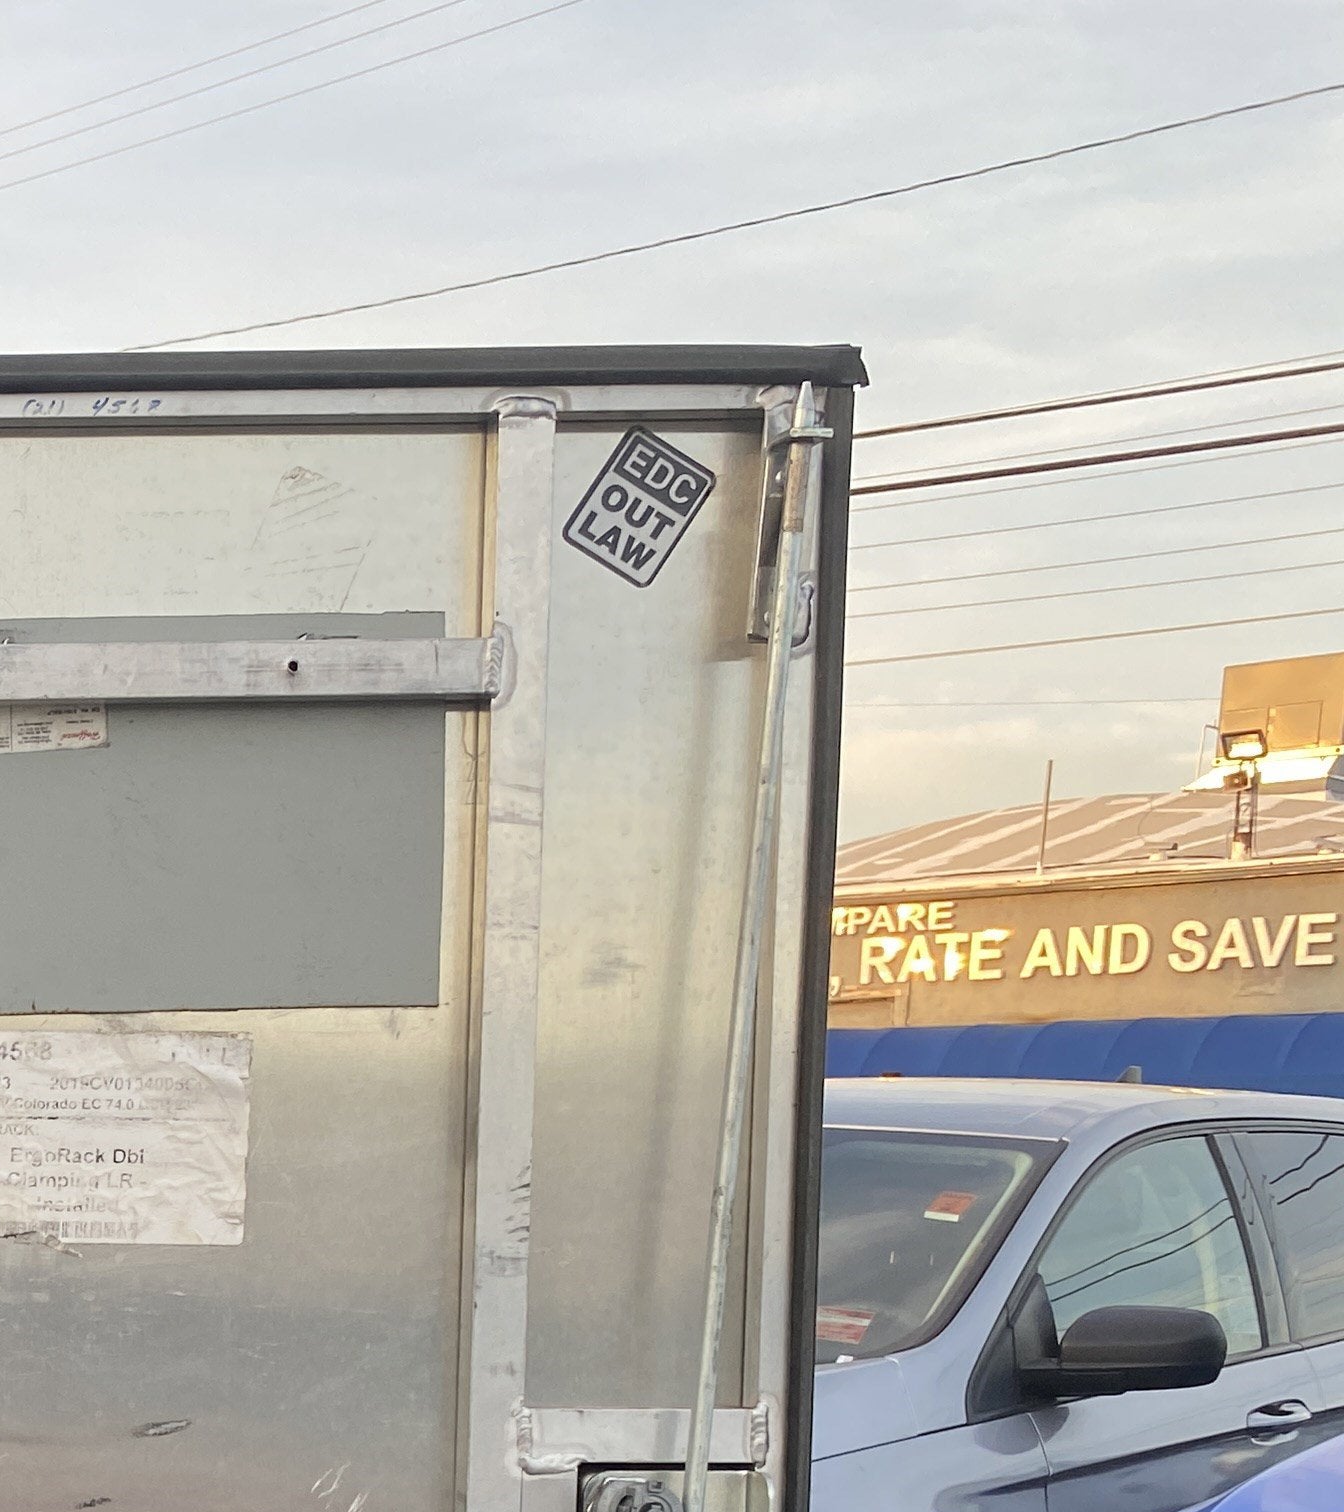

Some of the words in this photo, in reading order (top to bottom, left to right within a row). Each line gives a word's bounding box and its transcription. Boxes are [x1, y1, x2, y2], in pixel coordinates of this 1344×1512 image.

[622, 442, 698, 505] EDC
[577, 510, 658, 572] LAW
[600, 483, 677, 541] OUT
[859, 928, 1012, 987] RATE
[1019, 921, 1152, 979] AND
[1168, 911, 1340, 974] SAVE
[14, 1097, 77, 1110] Colorado
[82, 1098, 101, 1110] EC
[10, 1147, 105, 1167] ErgoRack
[107, 1173, 132, 1187] LR
